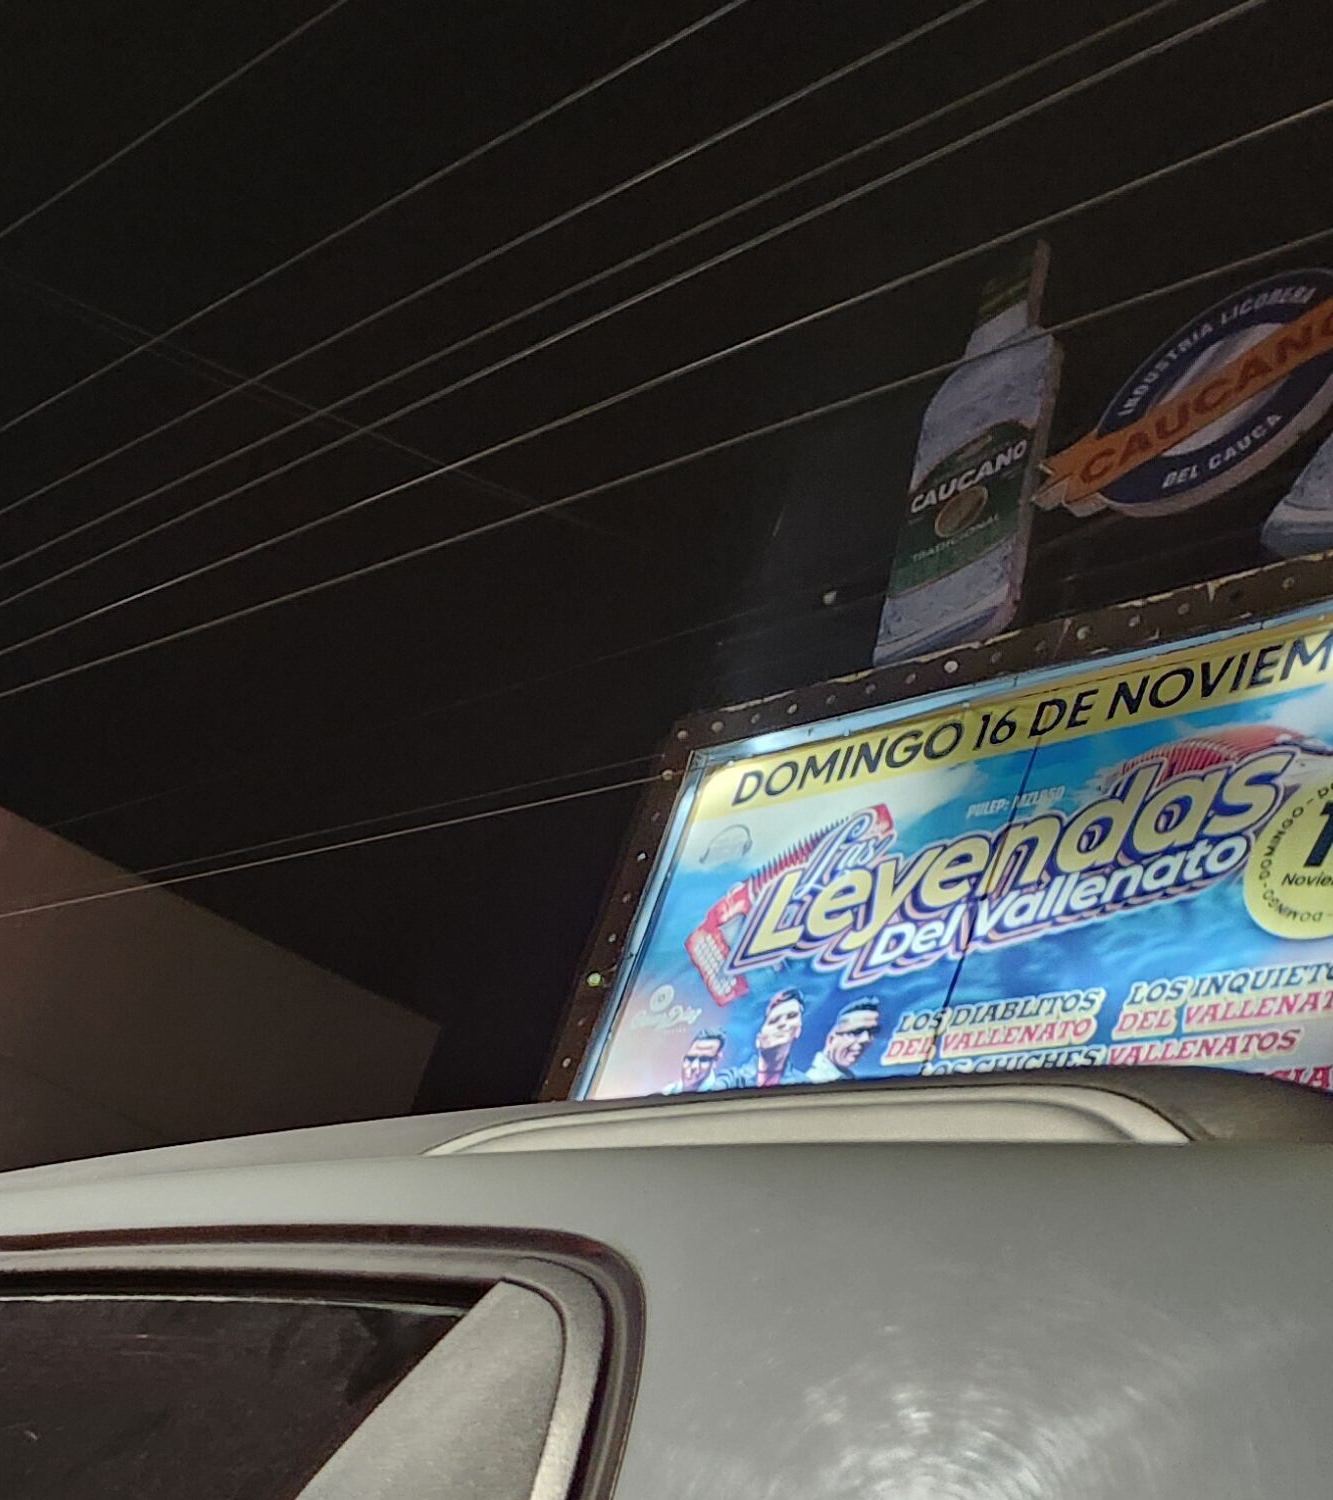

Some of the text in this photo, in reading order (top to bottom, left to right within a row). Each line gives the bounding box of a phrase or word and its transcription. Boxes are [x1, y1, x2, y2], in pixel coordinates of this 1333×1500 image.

[1118, 323, 1213, 416] INDUSTRIA
[911, 440, 1027, 513] CAUCANO
[1162, 413, 1282, 489] DEL CAUCA
[731, 630, 1333, 807] DOMINGO 16 DE NOVIEM
[741, 750, 1296, 960] Leyendas
[1281, 871, 1333, 887] Novie
[868, 835, 1249, 967] Del Vallenato
[896, 990, 1103, 1034] LOS DIABLITOS
[1116, 1008, 1174, 1033] DEL
[1127, 979, 1188, 1005] LOS
[886, 1018, 1093, 1059] DEL VALLENATO
[1108, 1029, 1301, 1065] VALLENATOS
